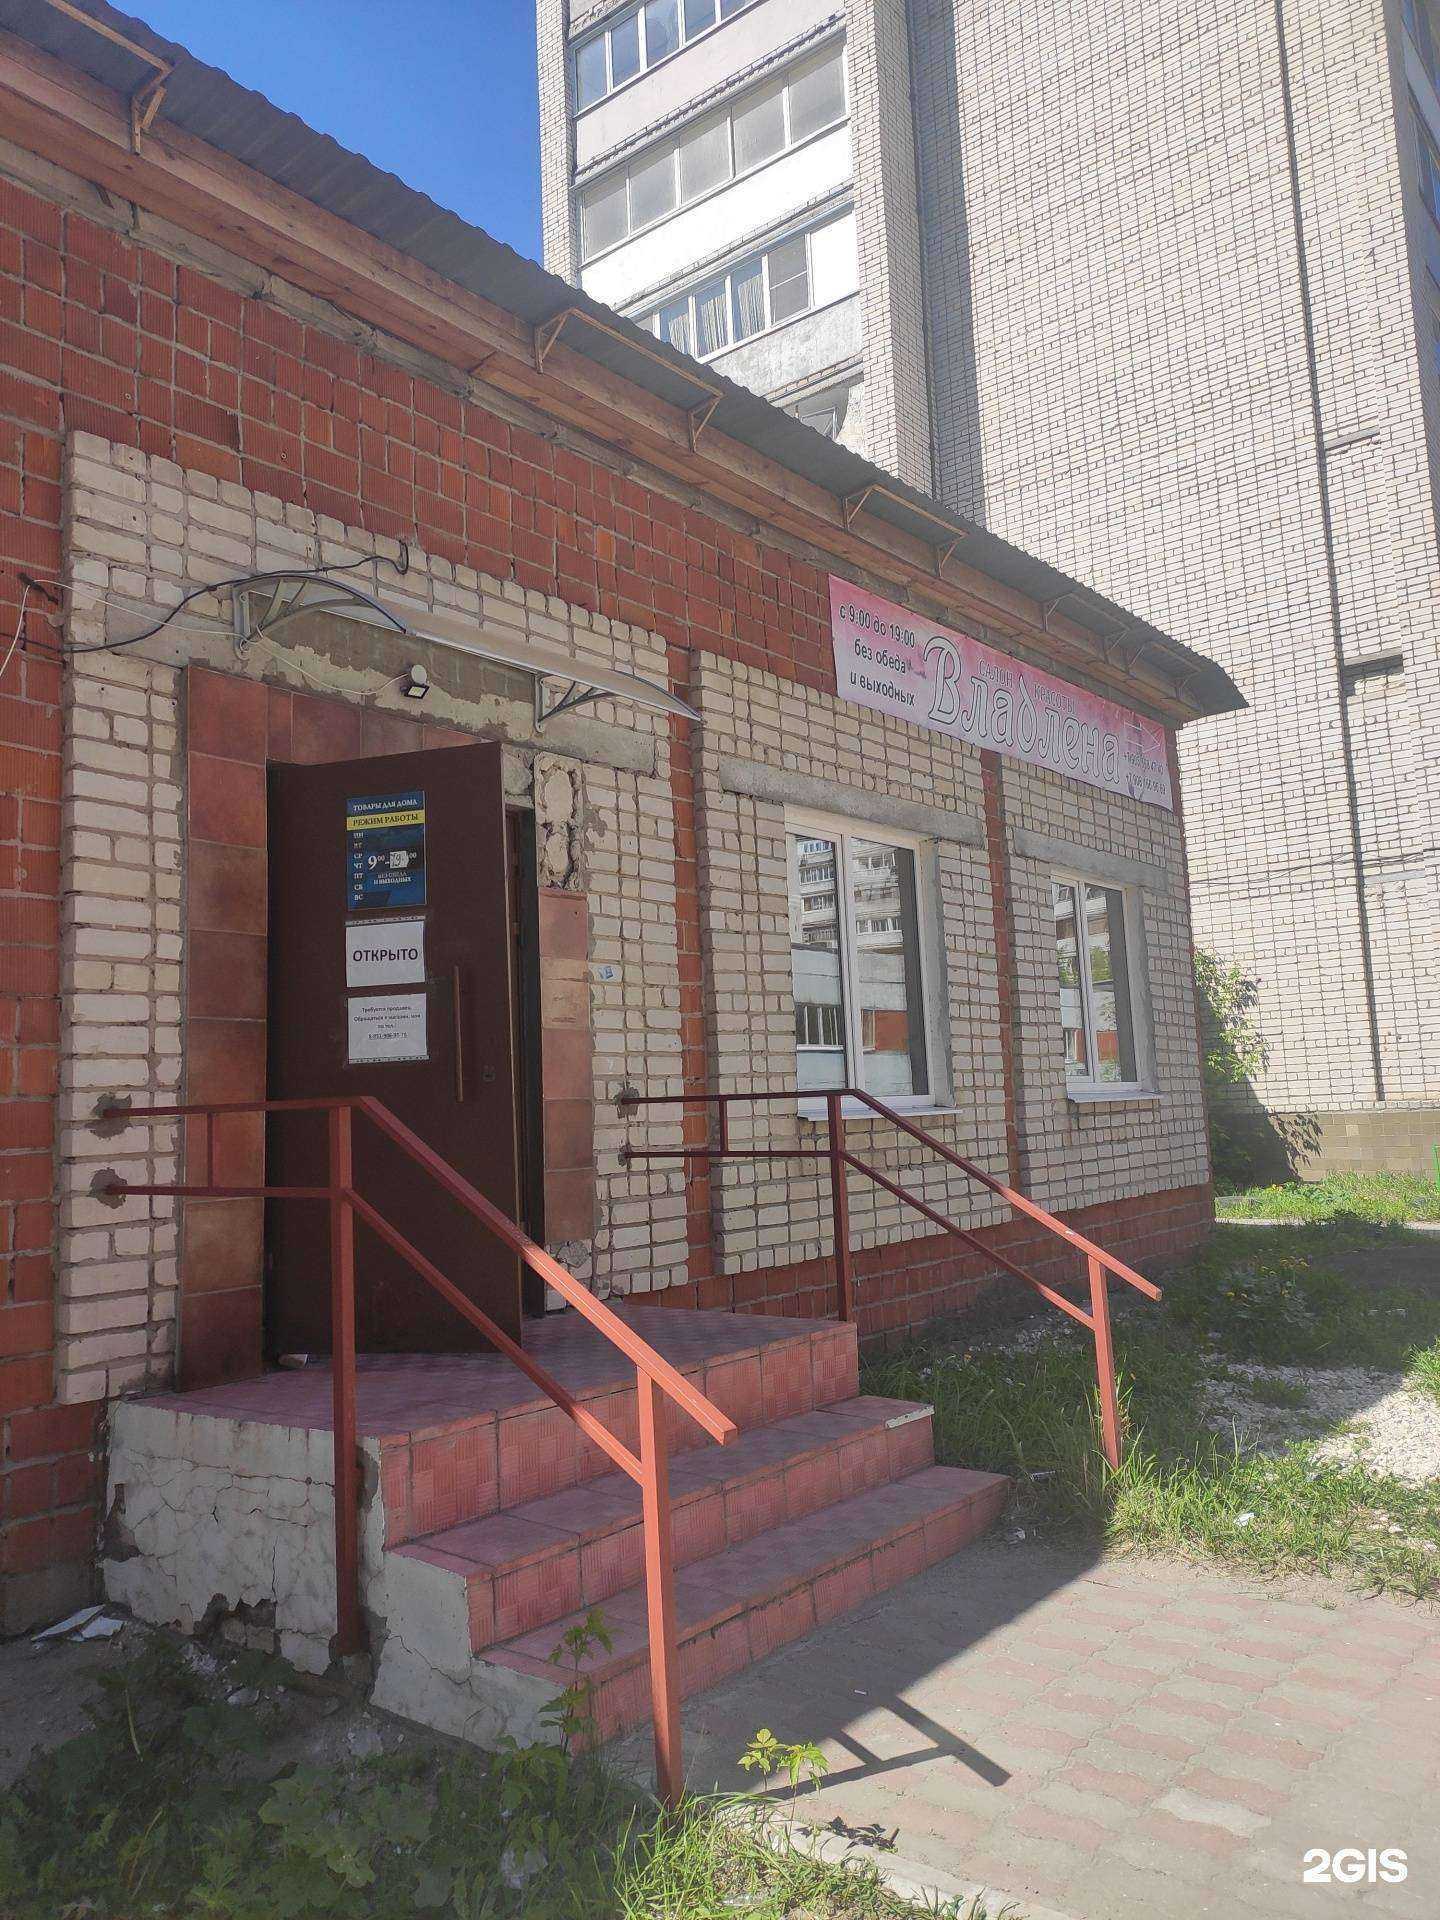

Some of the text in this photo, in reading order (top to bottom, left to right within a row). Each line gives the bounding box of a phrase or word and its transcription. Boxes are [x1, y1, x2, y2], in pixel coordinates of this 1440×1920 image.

[849, 605, 871, 629] 9:00
[873, 615, 887, 636] до
[889, 623, 916, 648] 19:00
[854, 638, 906, 674] без обеда
[850, 671, 916, 707] и выходных
[923, 635, 1120, 785] Владлена
[352, 802, 382, 811] ТОВАРЫ
[396, 799, 418, 808] ДОМА
[352, 813, 418, 826] РЕЖИМ РАБОТЫ
[353, 948, 418, 962] ОТКРЫТО
